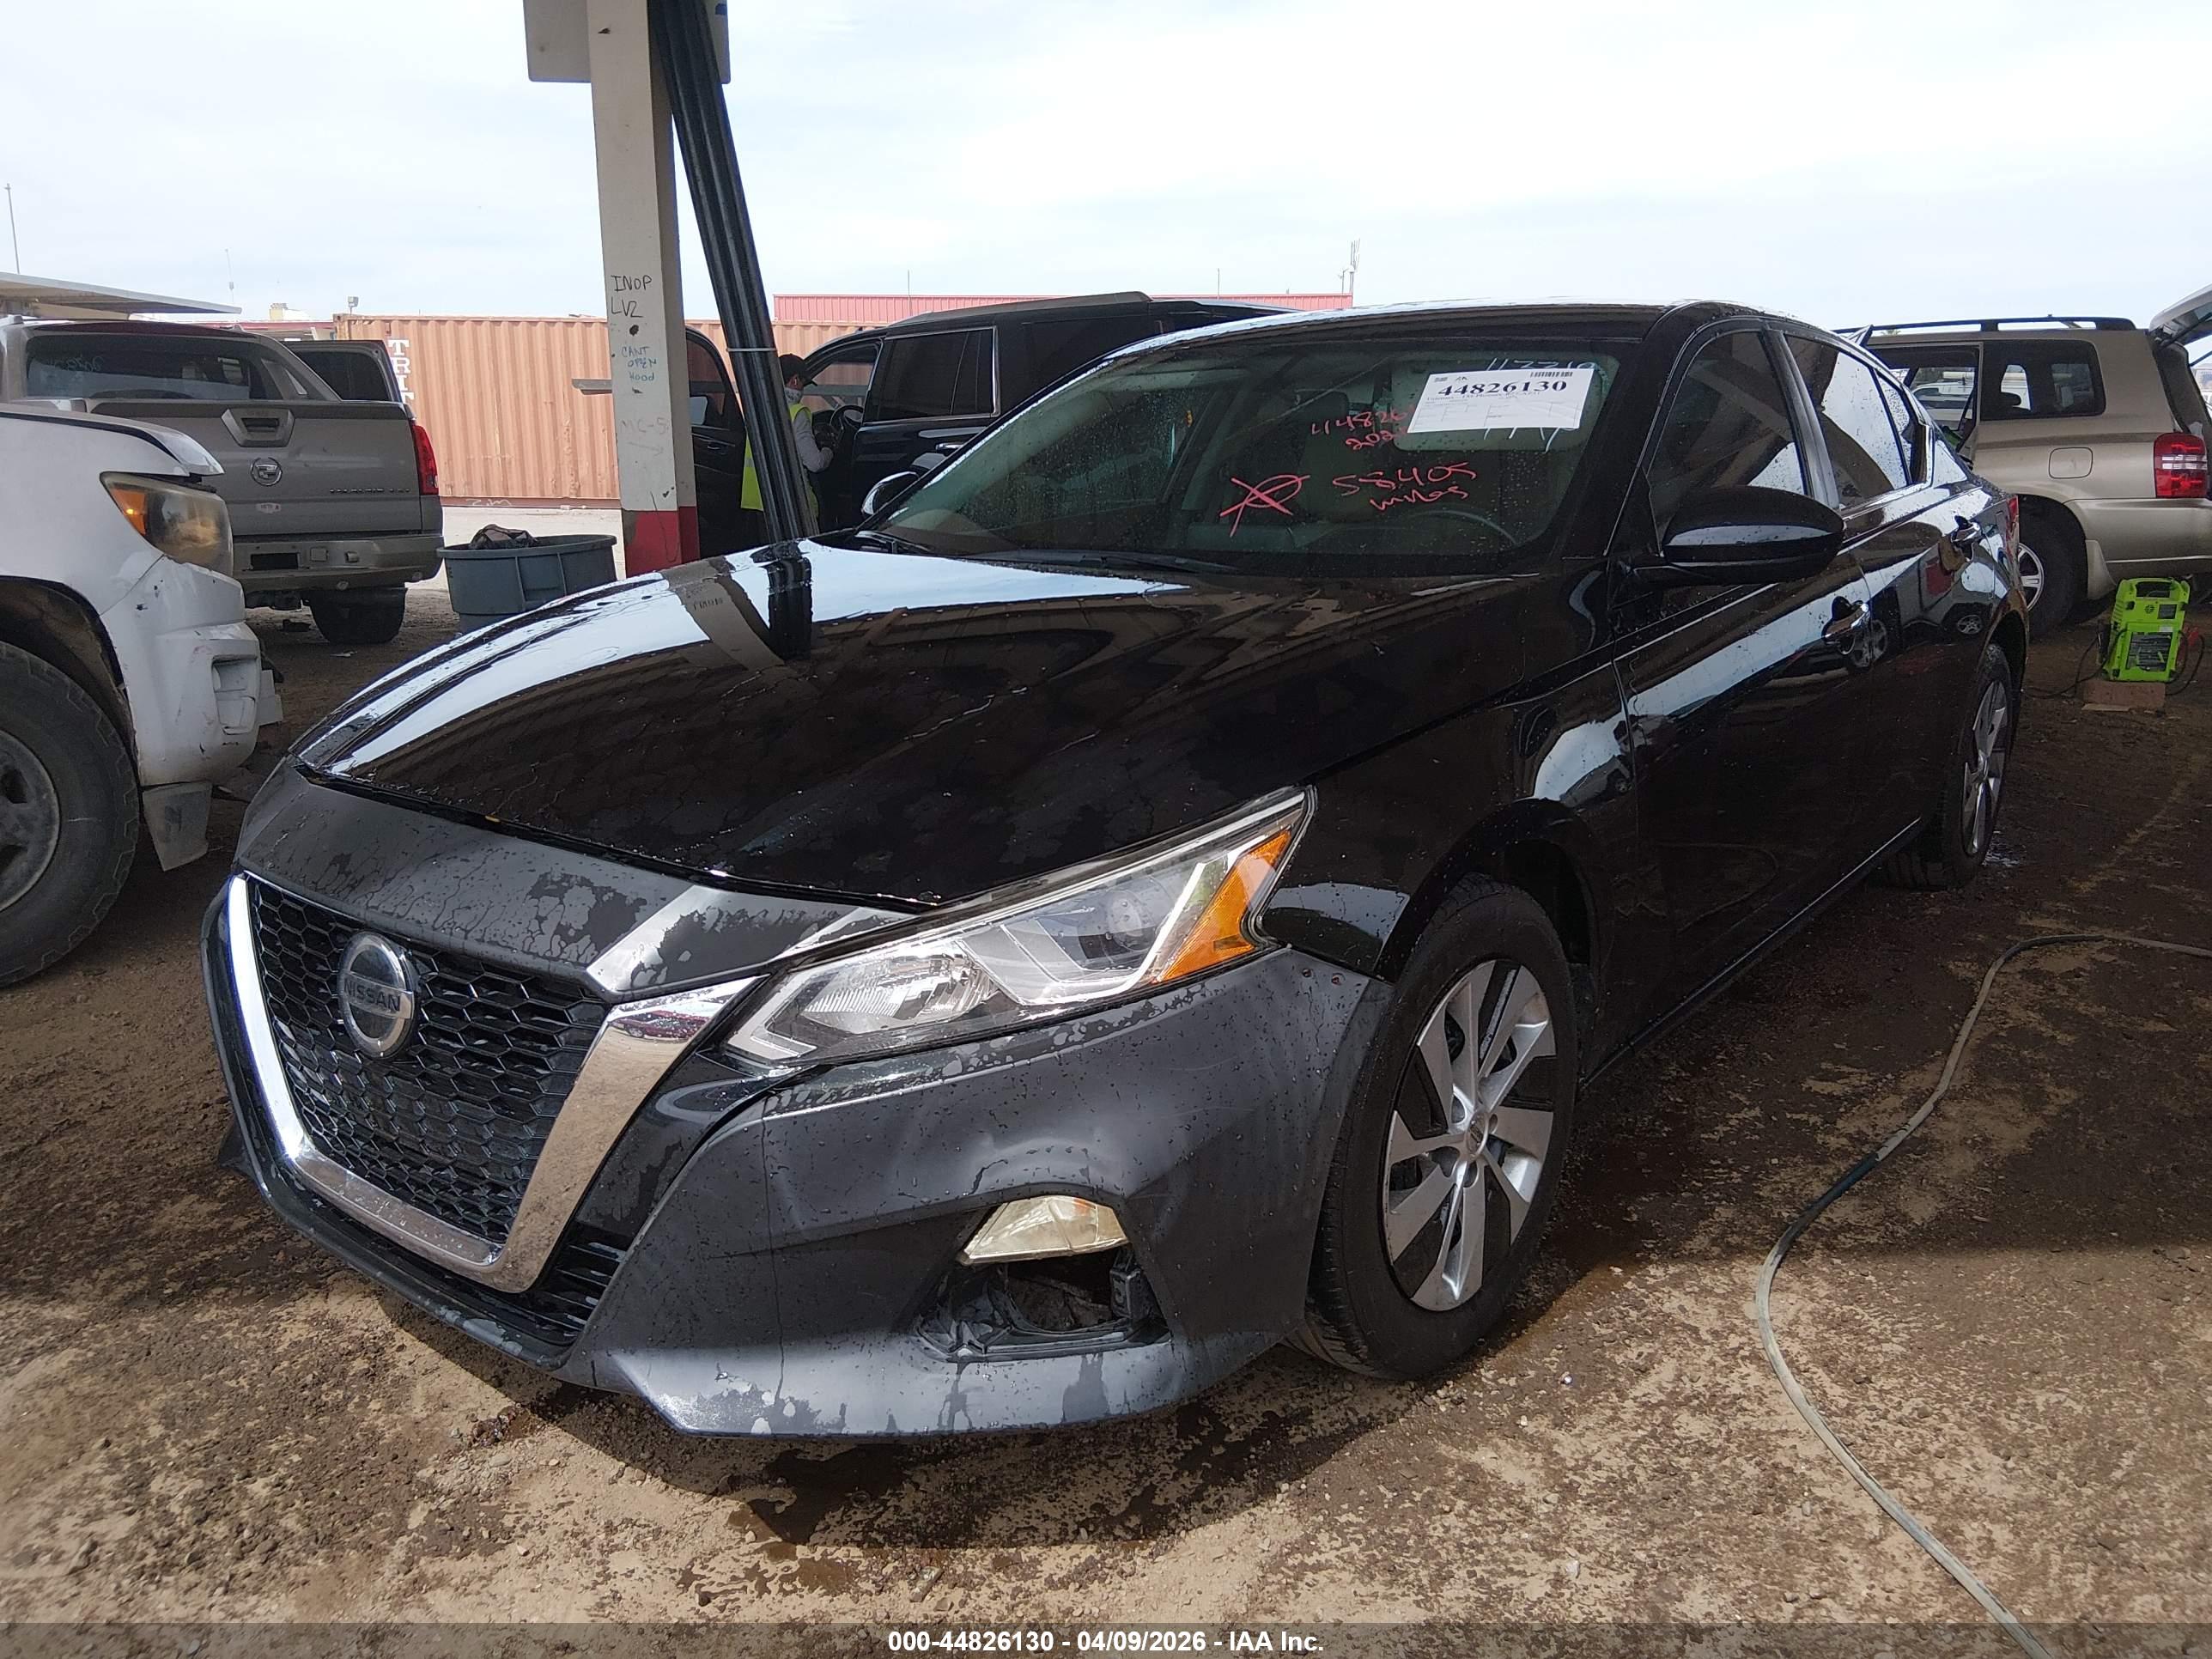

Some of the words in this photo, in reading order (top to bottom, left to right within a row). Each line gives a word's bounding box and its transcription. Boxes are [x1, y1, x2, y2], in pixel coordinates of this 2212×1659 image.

[611, 275, 653, 292] INOP
[621, 346, 650, 358] CANT
[388, 339, 414, 403] TRI
[628, 357, 658, 369] OPEN
[1437, 380, 1568, 397] 44826130
[344, 978, 401, 1012] NISSAN
